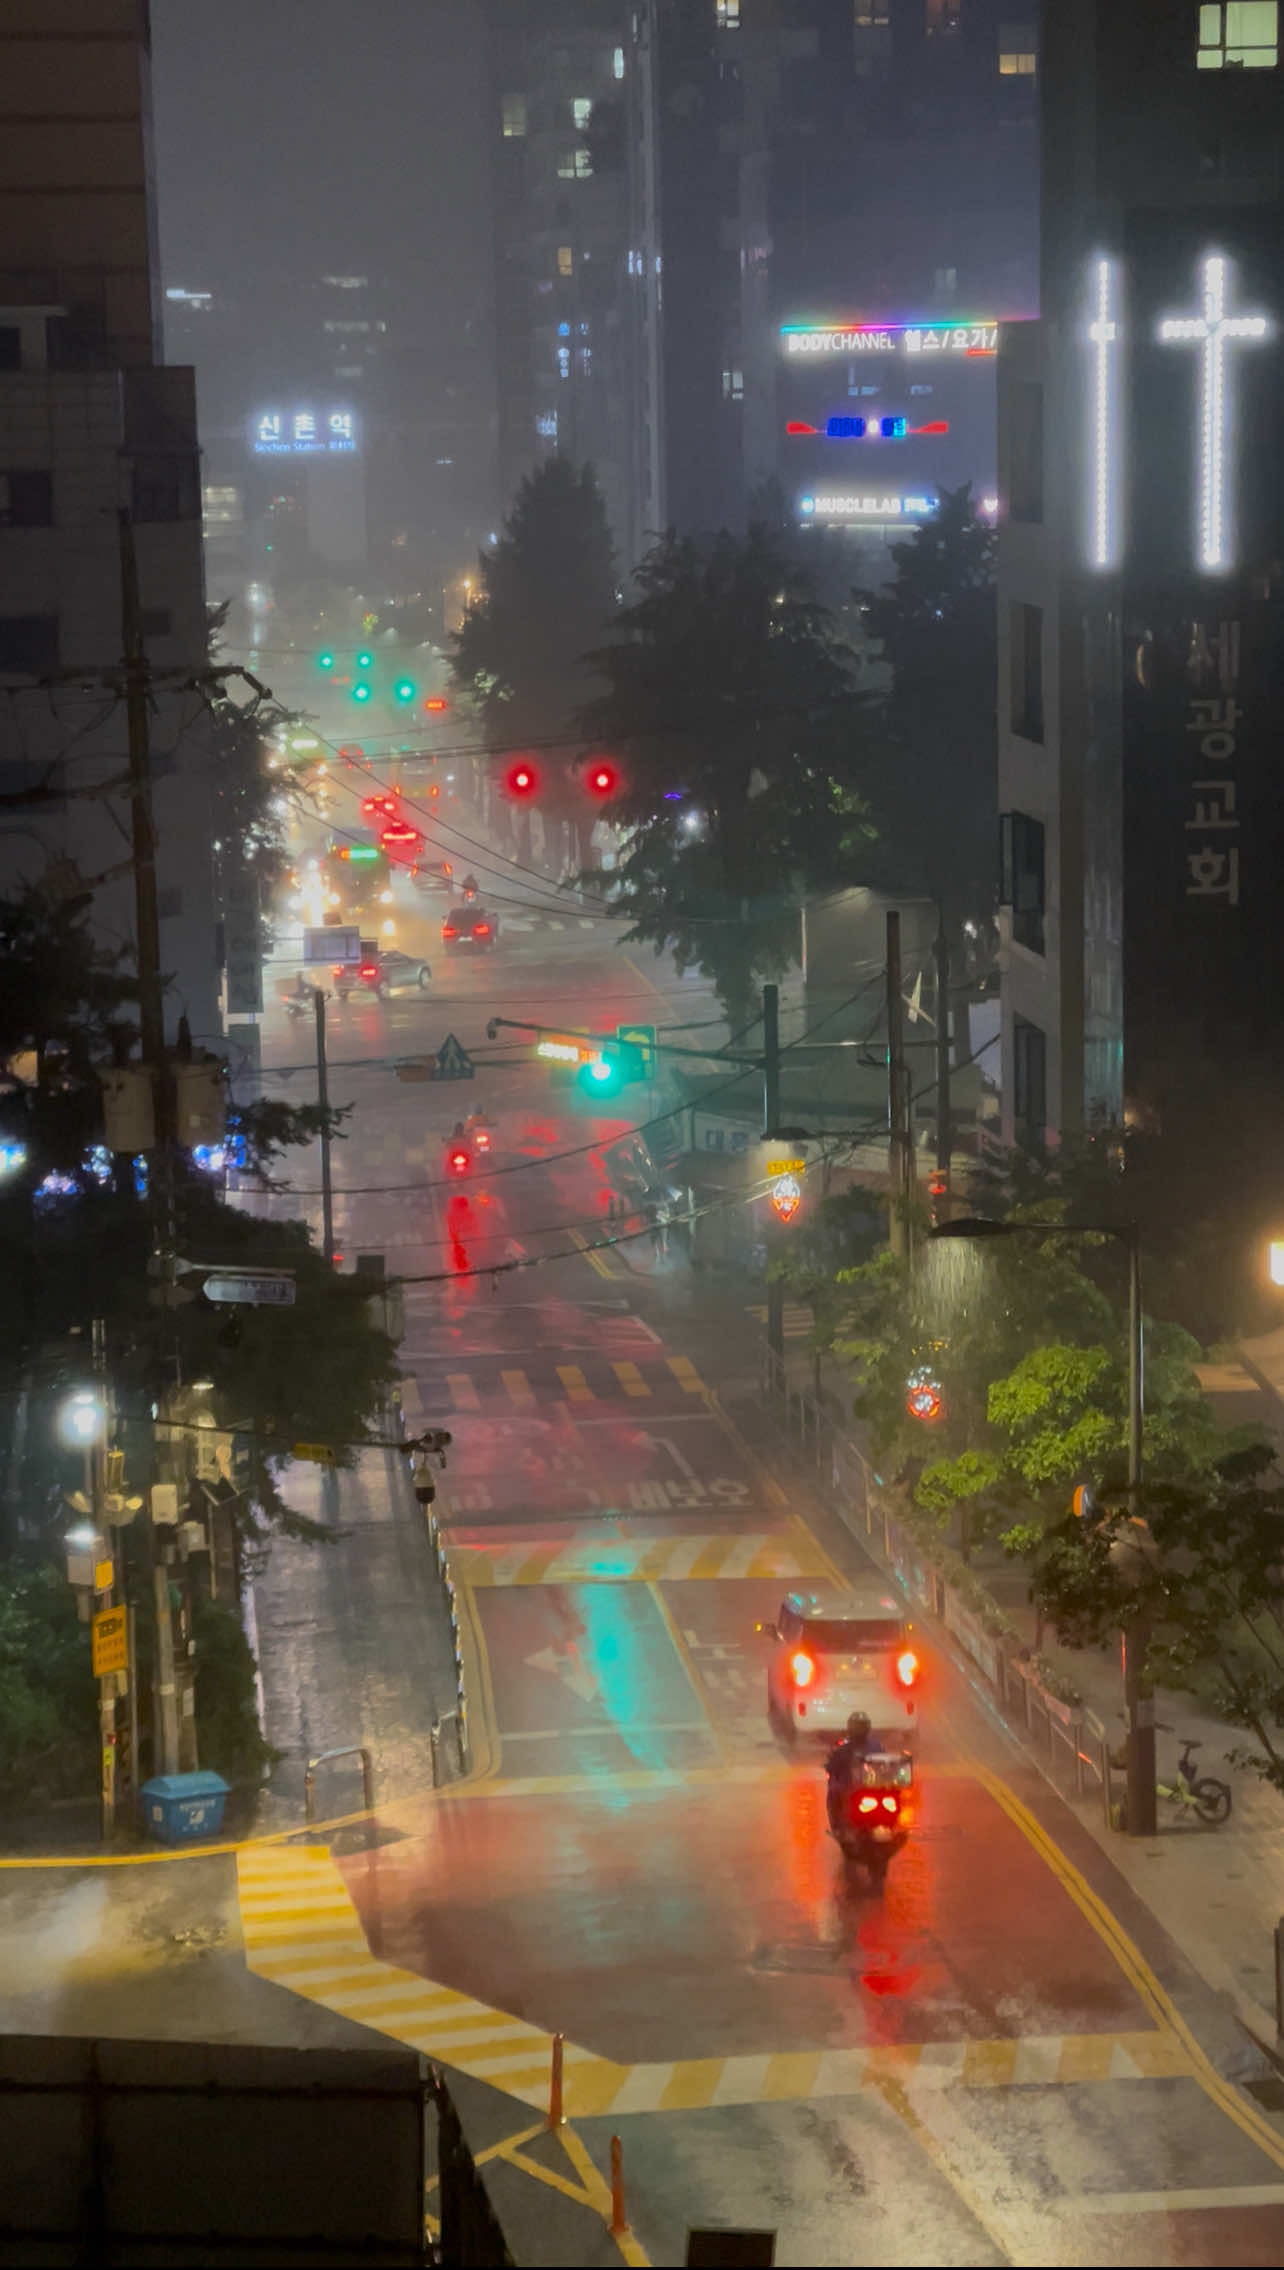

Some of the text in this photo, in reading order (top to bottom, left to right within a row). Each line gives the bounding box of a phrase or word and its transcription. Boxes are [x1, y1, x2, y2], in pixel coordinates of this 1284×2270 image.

[788, 332, 896, 352] BODYCHANNEL
[258, 414, 353, 441] 신촌역
[815, 497, 901, 514] MUSCLELAB
[1185, 621, 1243, 906] 세광교회
